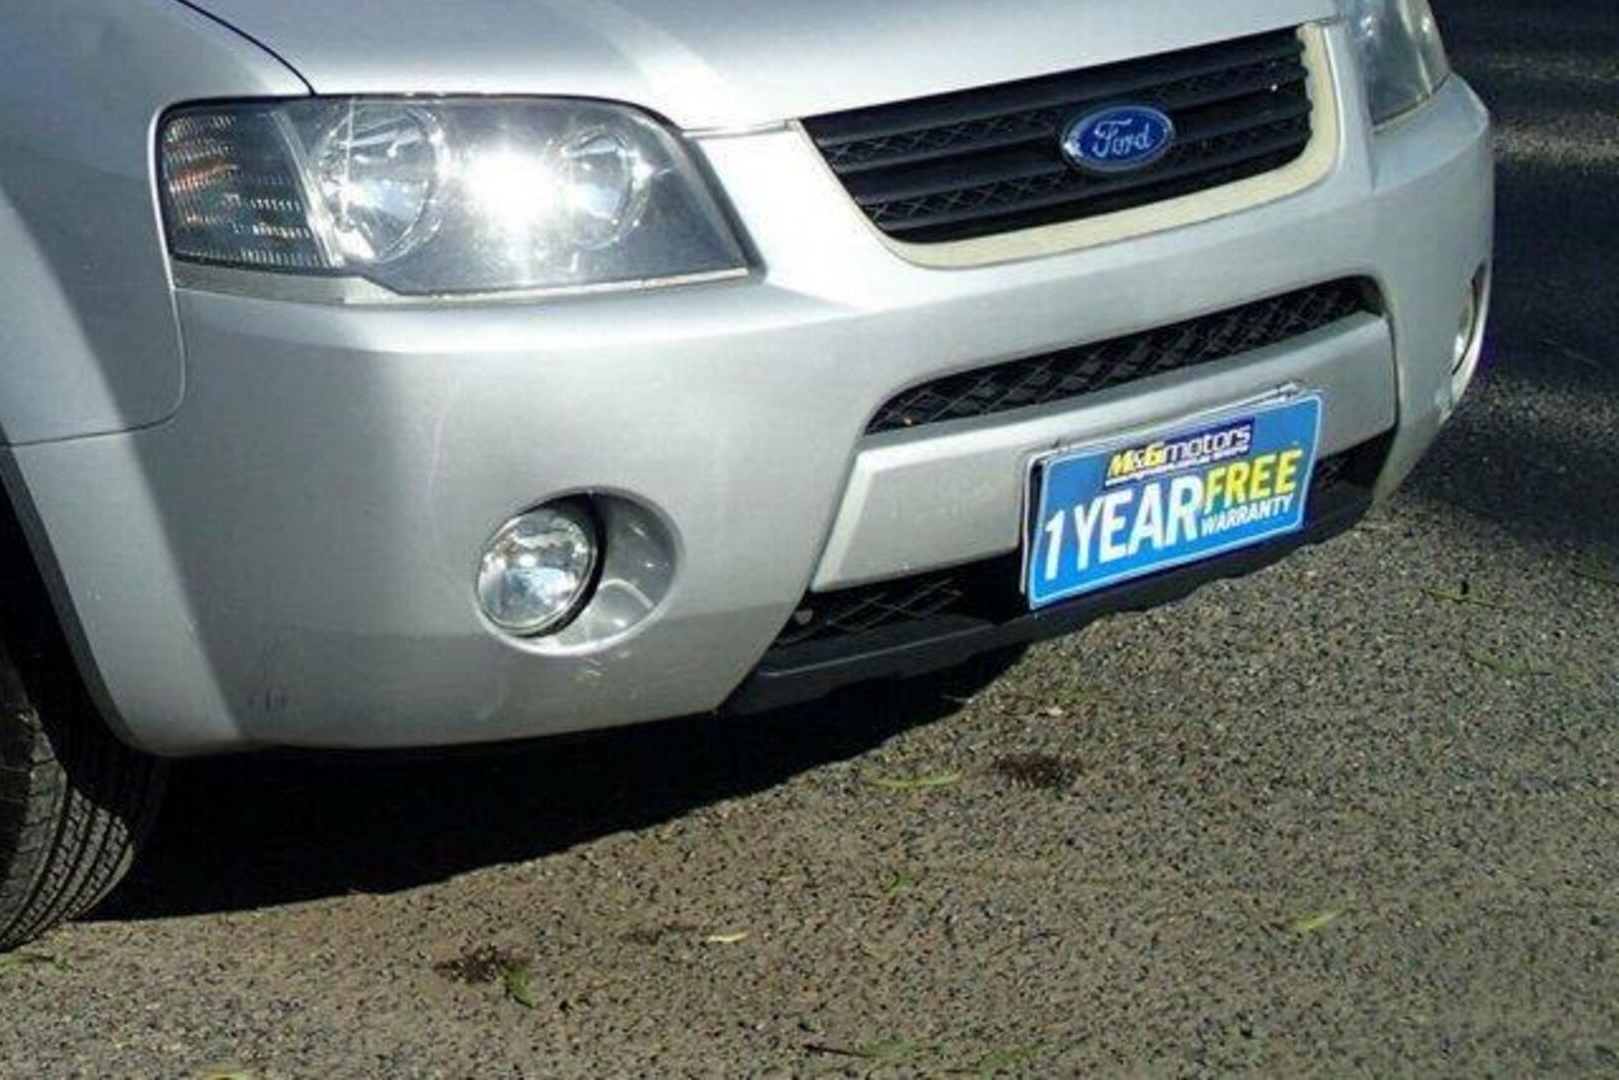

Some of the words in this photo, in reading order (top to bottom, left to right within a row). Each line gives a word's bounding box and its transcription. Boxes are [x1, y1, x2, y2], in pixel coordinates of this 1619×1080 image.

[1092, 118, 1153, 158] Ford
[1044, 510, 1066, 581] 1
[1074, 475, 1204, 571] YEAR
[1204, 448, 1303, 516] FREE
[1202, 493, 1293, 536] WARRANTY
